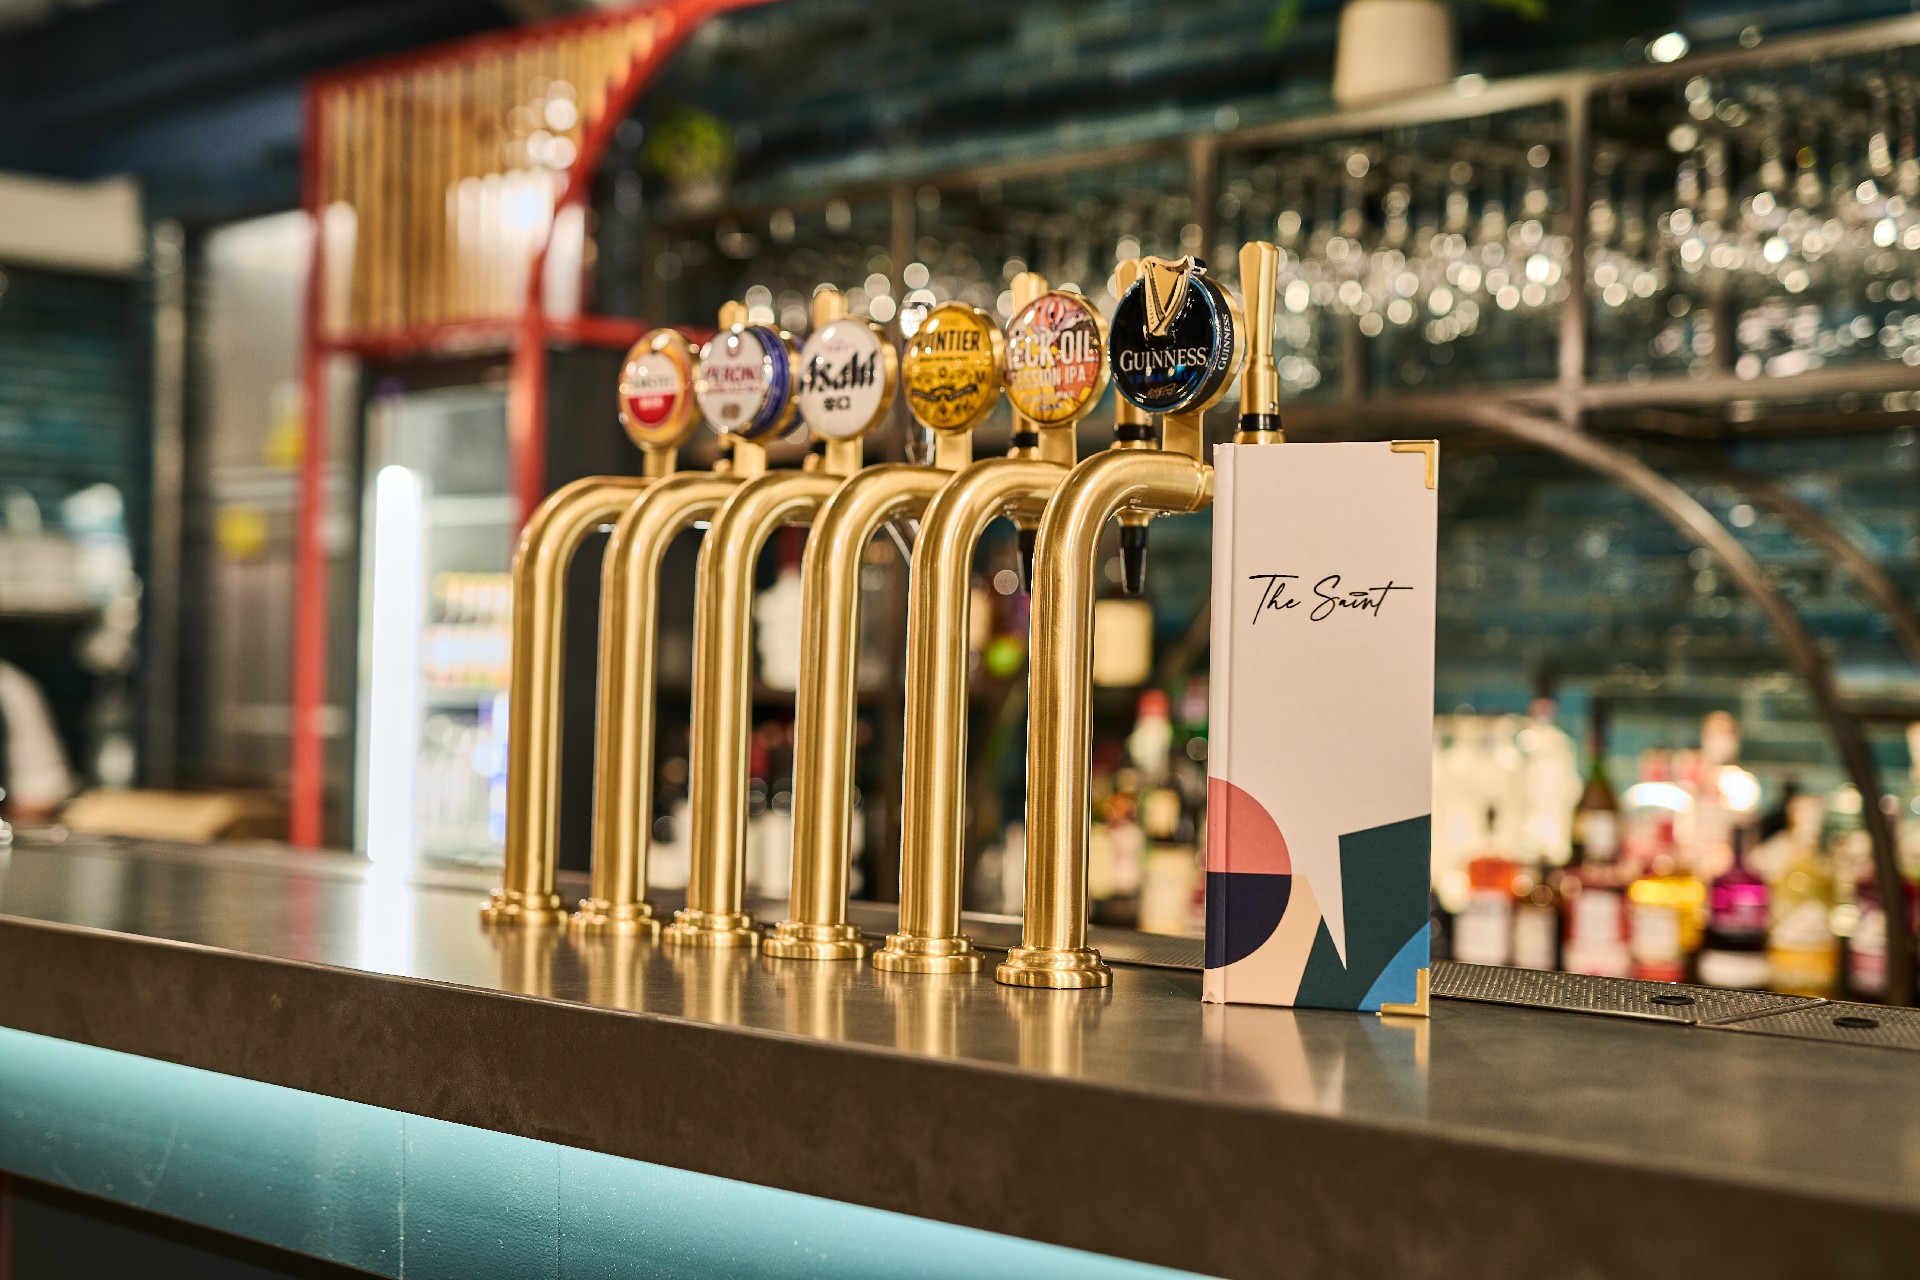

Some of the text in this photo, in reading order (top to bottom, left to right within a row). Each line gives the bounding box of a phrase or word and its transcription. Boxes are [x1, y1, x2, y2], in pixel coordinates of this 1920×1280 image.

[1120, 346, 1207, 372] GUINNESS
[1217, 313, 1231, 371] GUINNESS
[1064, 364, 1086, 385] IPA
[1249, 574, 1413, 625] The Saint
